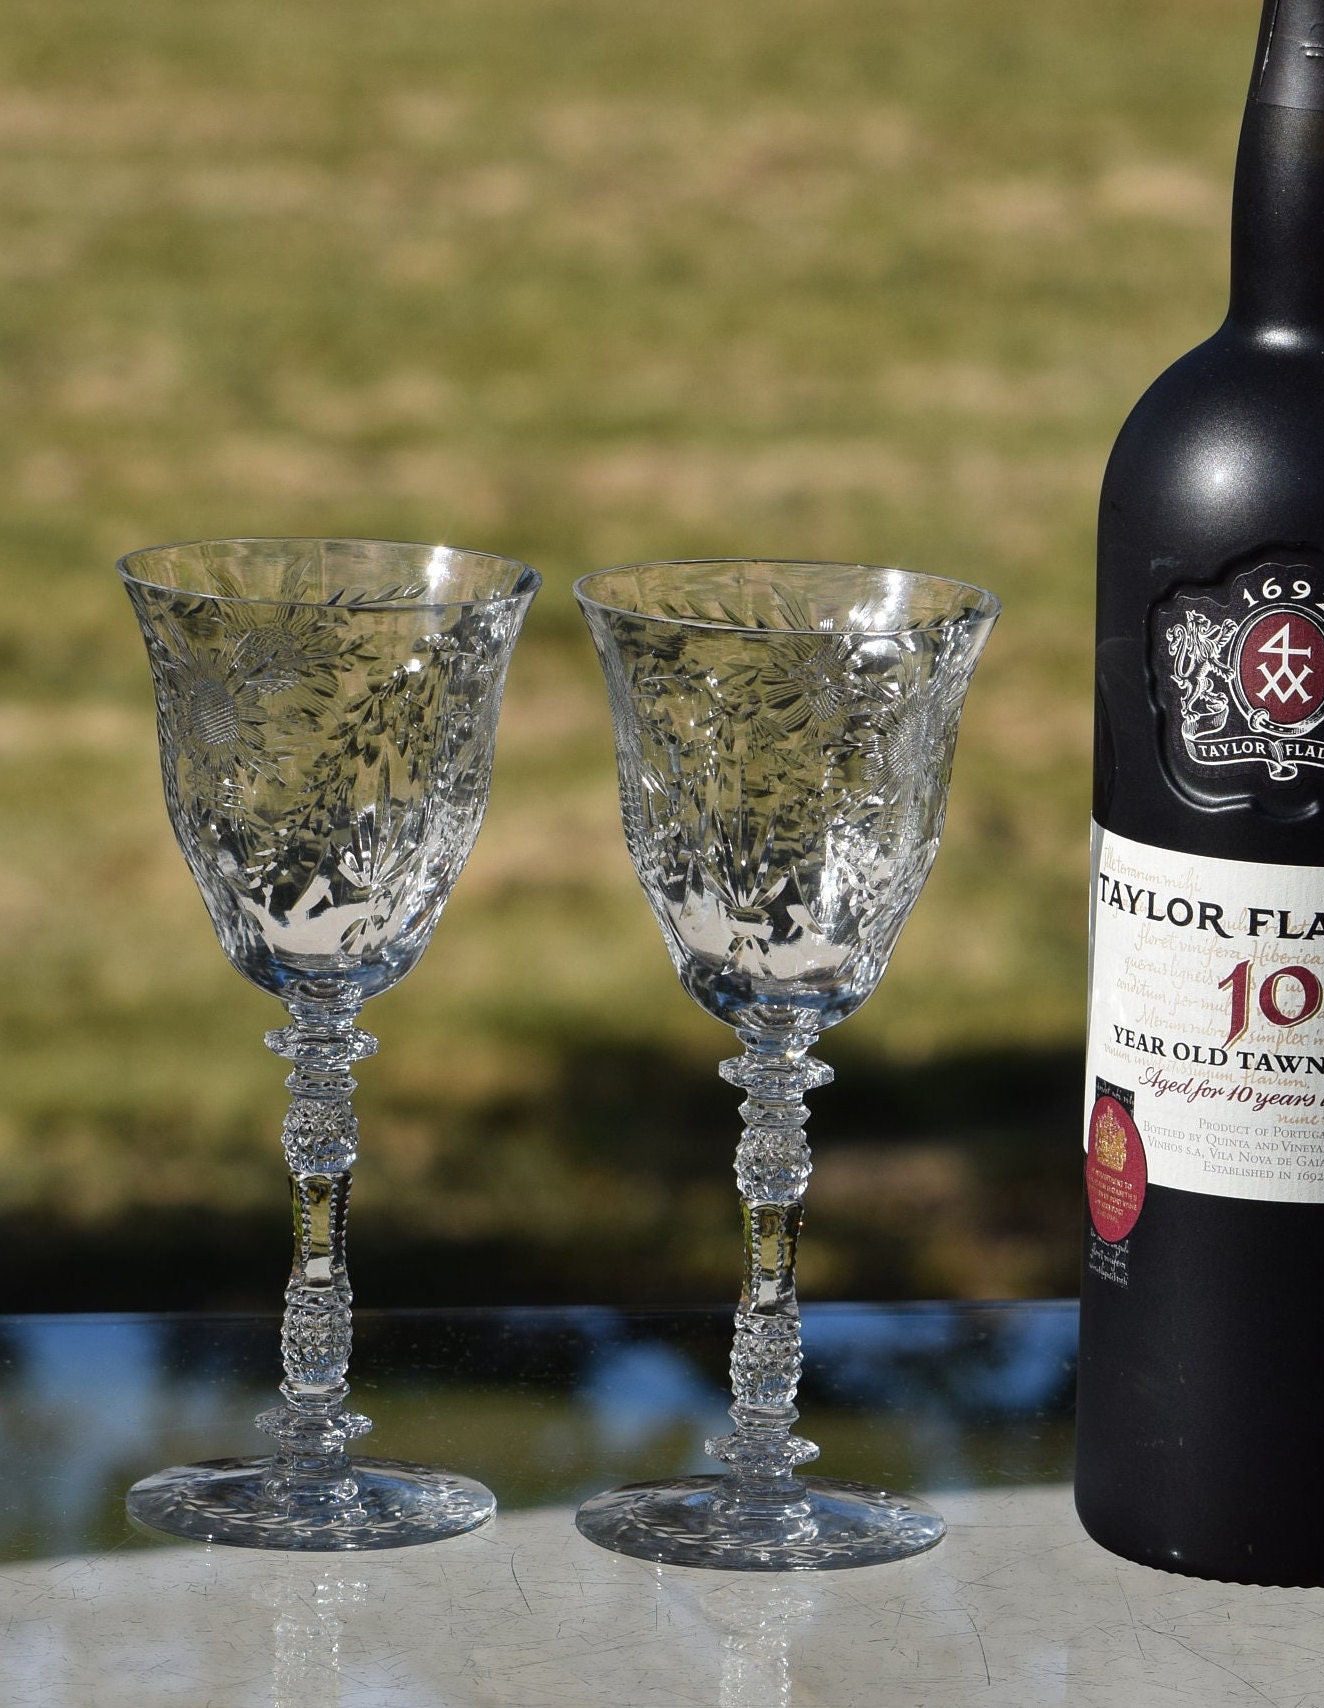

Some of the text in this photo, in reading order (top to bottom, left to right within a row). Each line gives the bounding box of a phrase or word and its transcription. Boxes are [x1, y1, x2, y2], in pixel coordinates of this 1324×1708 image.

[1198, 741, 1266, 757] TAYLOR
[1099, 872, 1234, 939] TAYLOR
[1218, 959, 1324, 1050] 10
[1113, 1025, 1167, 1057] YEAR
[1173, 1042, 1228, 1066] OLD
[1139, 1067, 1194, 1097] Aged
[1188, 1079, 1225, 1103] for
[1227, 1085, 1253, 1103] 10
[1252, 1093, 1316, 1111] years
[1143, 1120, 1185, 1140] BOTTLED
[1189, 1132, 1202, 1143] BY
[1205, 1133, 1250, 1150] QUINTA
[1255, 1141, 1279, 1151] AND
[1199, 1117, 1250, 1134] PRODUCT
[1254, 1127, 1269, 1137] OF
[1147, 1135, 1183, 1153] VINHOS
[1209, 1147, 1234, 1161] VILA
[1239, 1151, 1272, 1165] NOVA
[1277, 1156, 1291, 1166] DE
[1203, 1160, 1324, 1183] ESTABLISHED IN 1692
